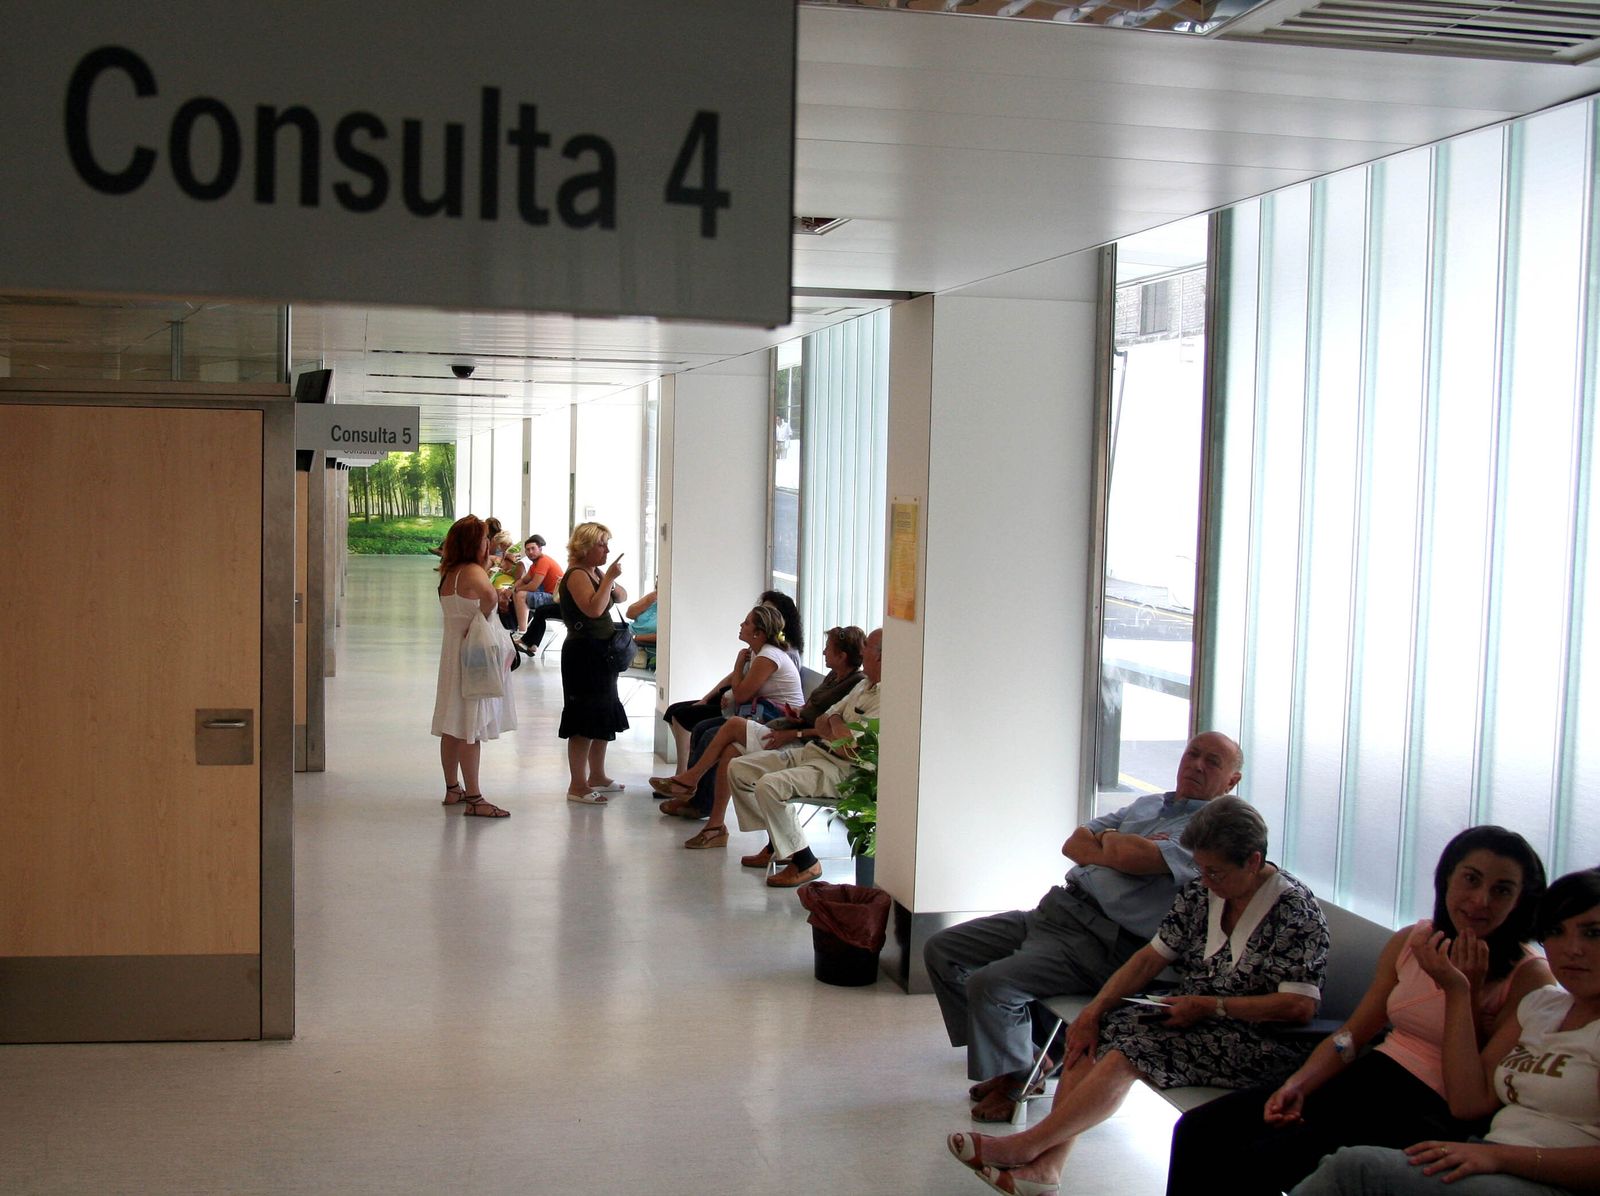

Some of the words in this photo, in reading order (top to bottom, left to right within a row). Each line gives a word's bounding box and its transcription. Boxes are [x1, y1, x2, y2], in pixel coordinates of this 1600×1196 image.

[64, 45, 617, 231] Consulta
[664, 110, 731, 238] 4
[331, 425, 397, 444] Consulta
[402, 427, 412, 444] 5
